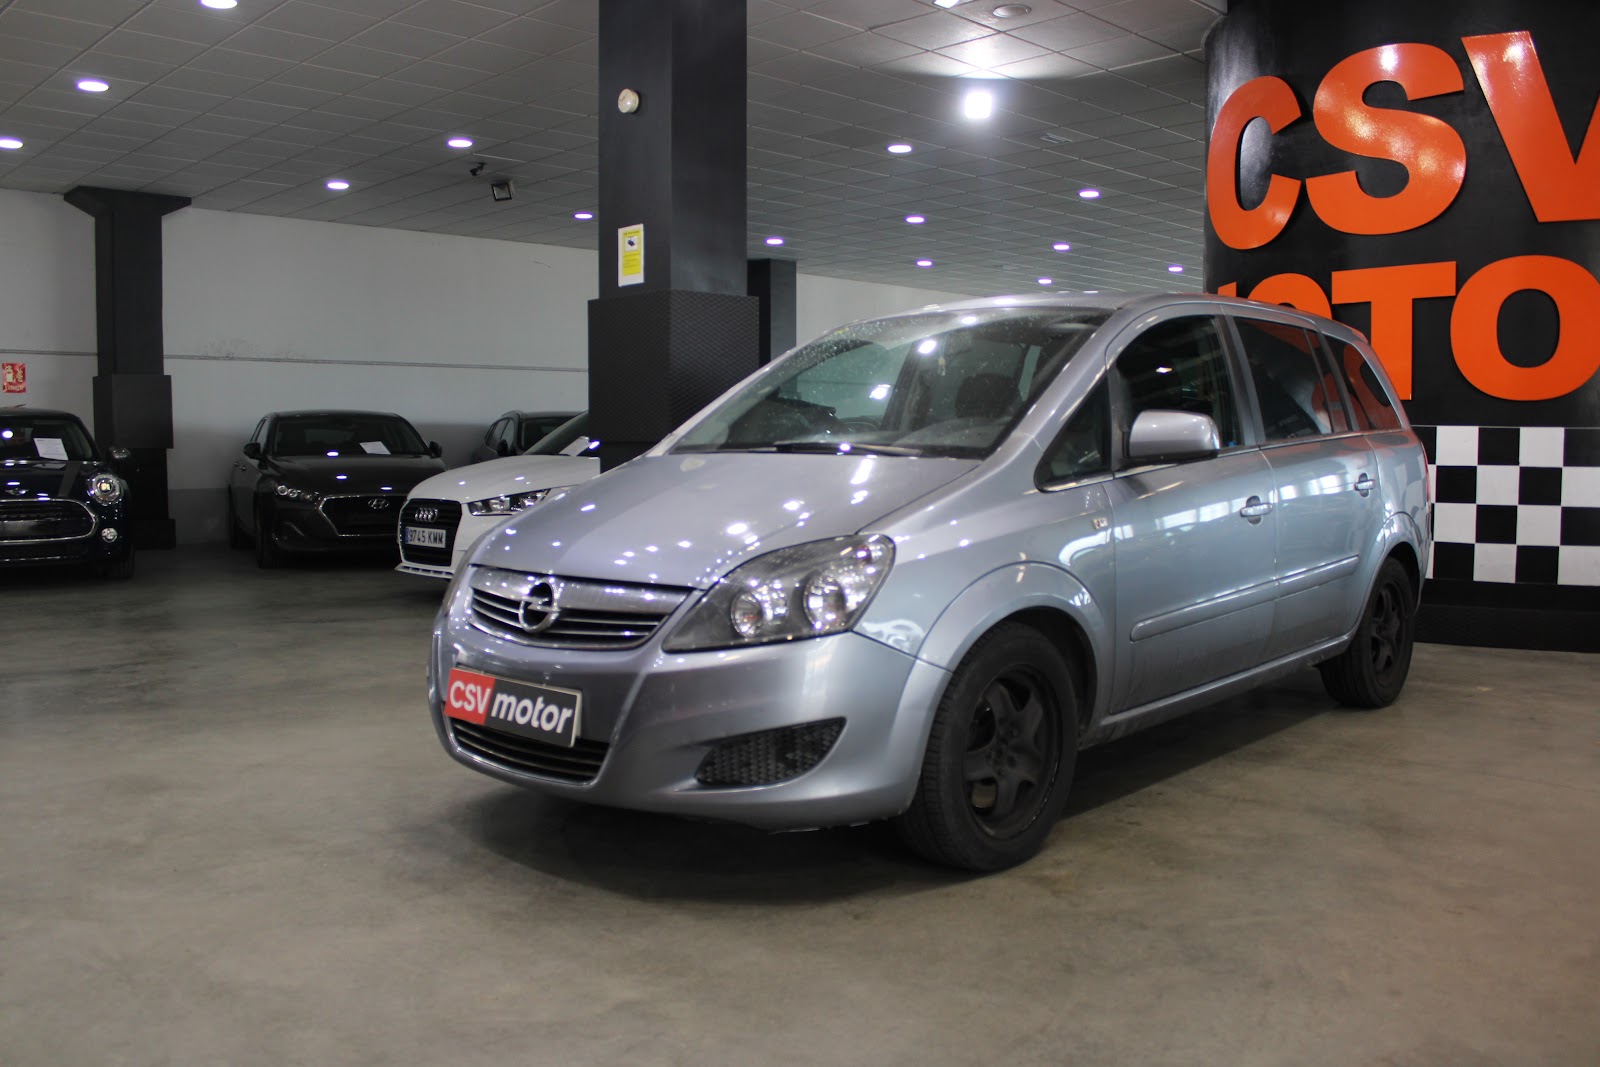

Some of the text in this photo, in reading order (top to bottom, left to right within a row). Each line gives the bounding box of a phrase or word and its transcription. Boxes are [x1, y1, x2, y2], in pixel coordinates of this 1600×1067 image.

[1207, 31, 1600, 249] CSV
[1217, 255, 1600, 400] TO
[409, 529, 426, 543] 9745
[450, 681, 573, 734] CSV motor
